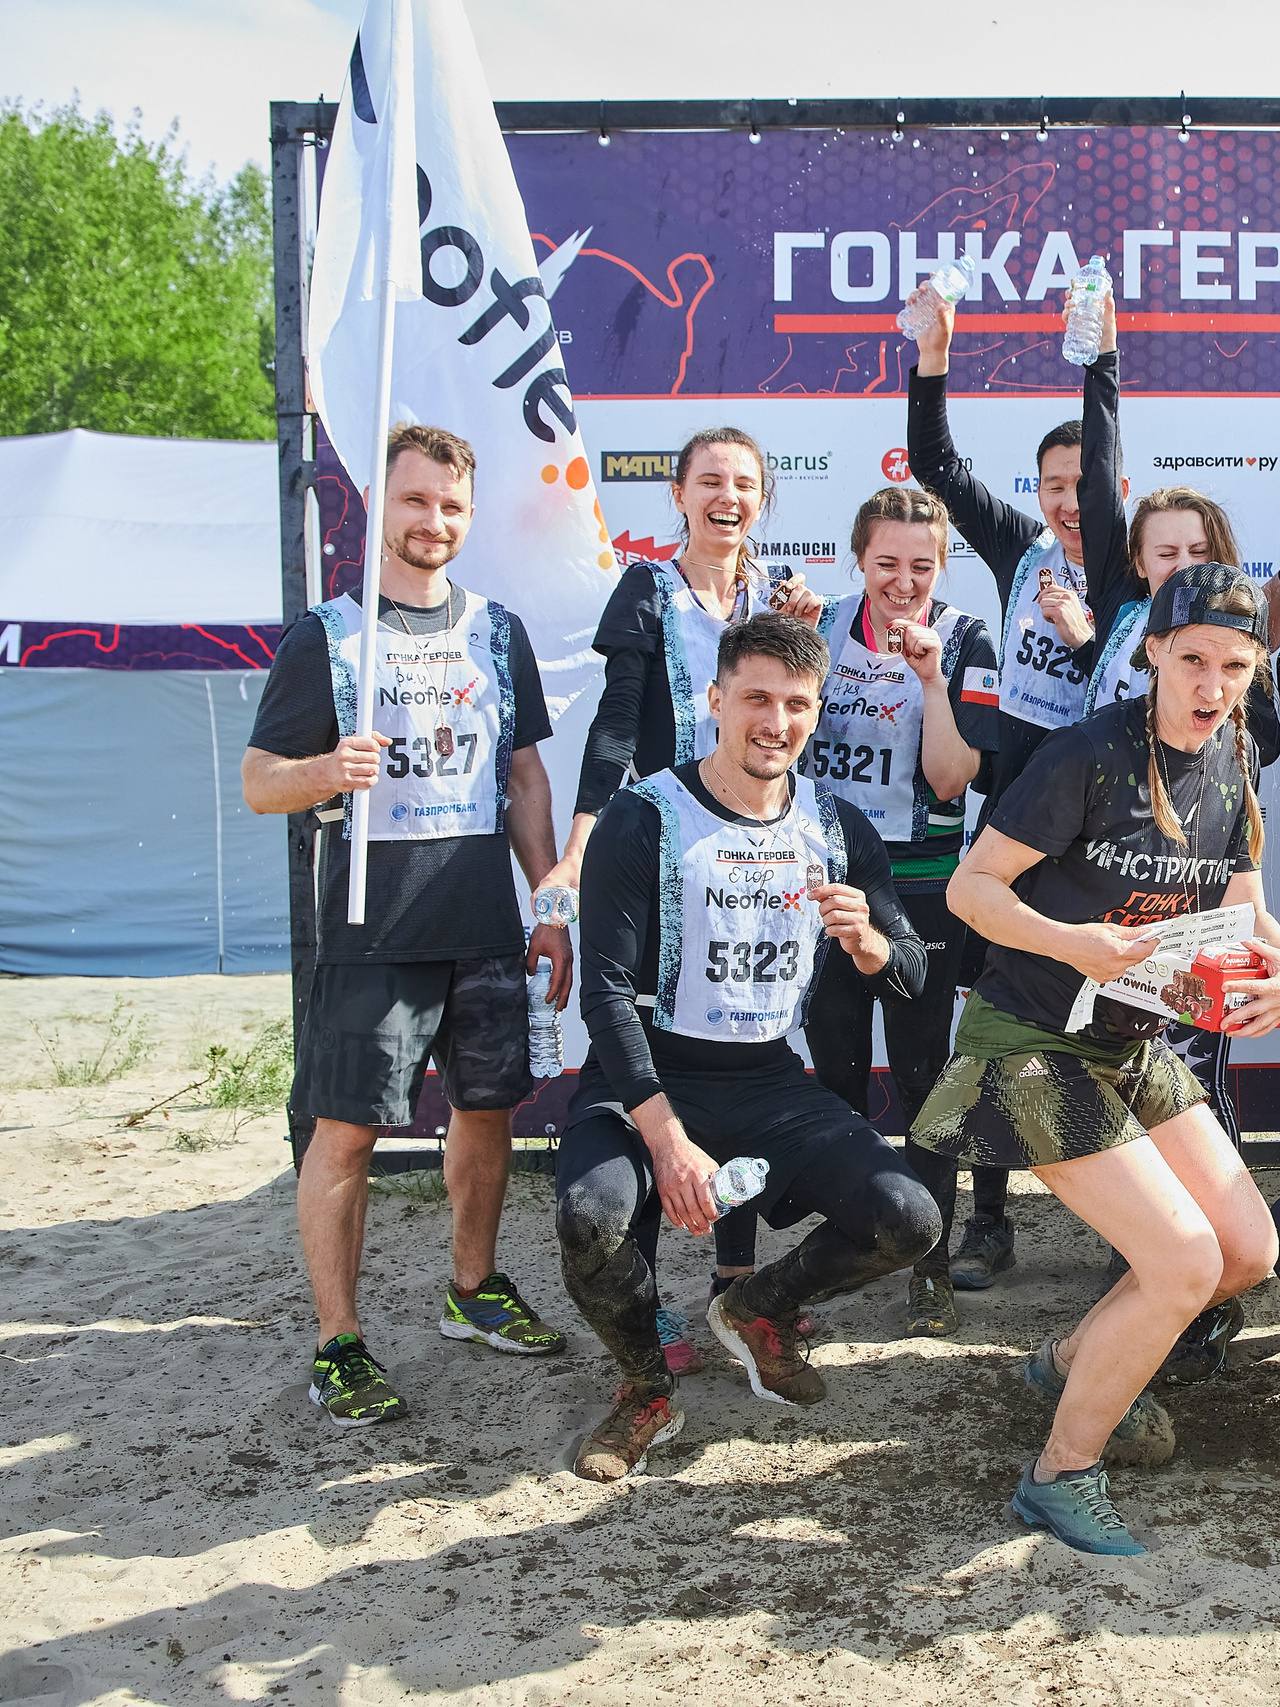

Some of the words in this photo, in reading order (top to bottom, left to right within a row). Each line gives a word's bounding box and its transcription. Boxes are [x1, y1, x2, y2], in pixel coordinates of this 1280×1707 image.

[774, 231, 1078, 302] ГОНКА
[766, 452, 829, 472] barus
[386, 653, 421, 661] ГОНКА
[423, 651, 462, 661] ГЕРОЕВ
[835, 664, 866, 680] ГОНКА
[1021, 692, 1071, 717] ГАЗПРОМБАНК
[813, 740, 893, 786] 5321
[414, 802, 478, 817] ГАЗПРОМБАНК
[717, 849, 755, 861] ГОНКА
[757, 850, 796, 861] ГЕРОЕВ
[705, 885, 807, 916] Neoflex
[705, 940, 800, 983] 5323
[1112, 976, 1158, 995] rownie
[729, 1009, 789, 1022] ГАЗПРОМБАНК
